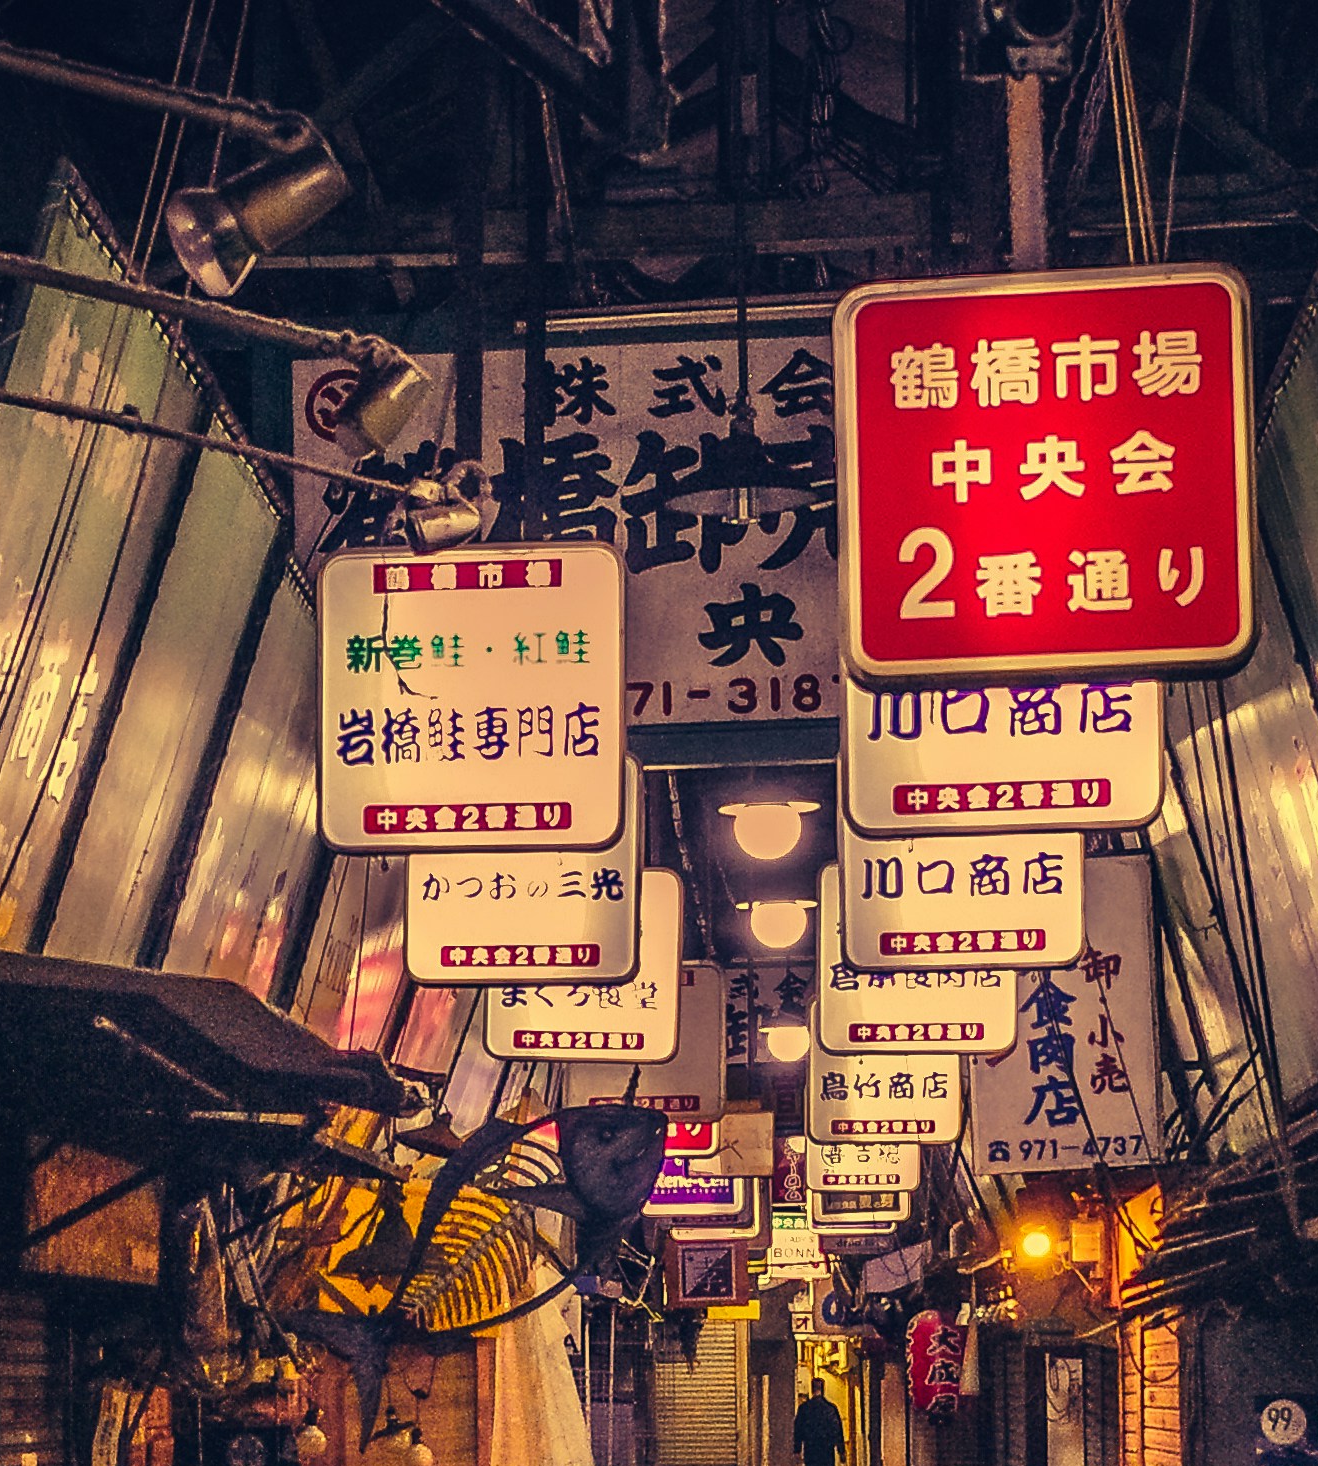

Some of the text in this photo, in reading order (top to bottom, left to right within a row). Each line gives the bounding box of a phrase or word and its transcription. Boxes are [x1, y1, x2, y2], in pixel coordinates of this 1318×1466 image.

[890, 329, 1203, 410] 鶴橋市場
[931, 429, 1176, 504] 中央会
[898, 526, 1205, 619] 2番通り
[907, 781, 1101, 812] 中央会2番通り
[376, 805, 562, 831] 中央会2番通り
[861, 852, 1064, 901] 川口商店
[449, 946, 592, 967] 中央会2番通り
[890, 929, 1039, 954] 中央会2番通り
